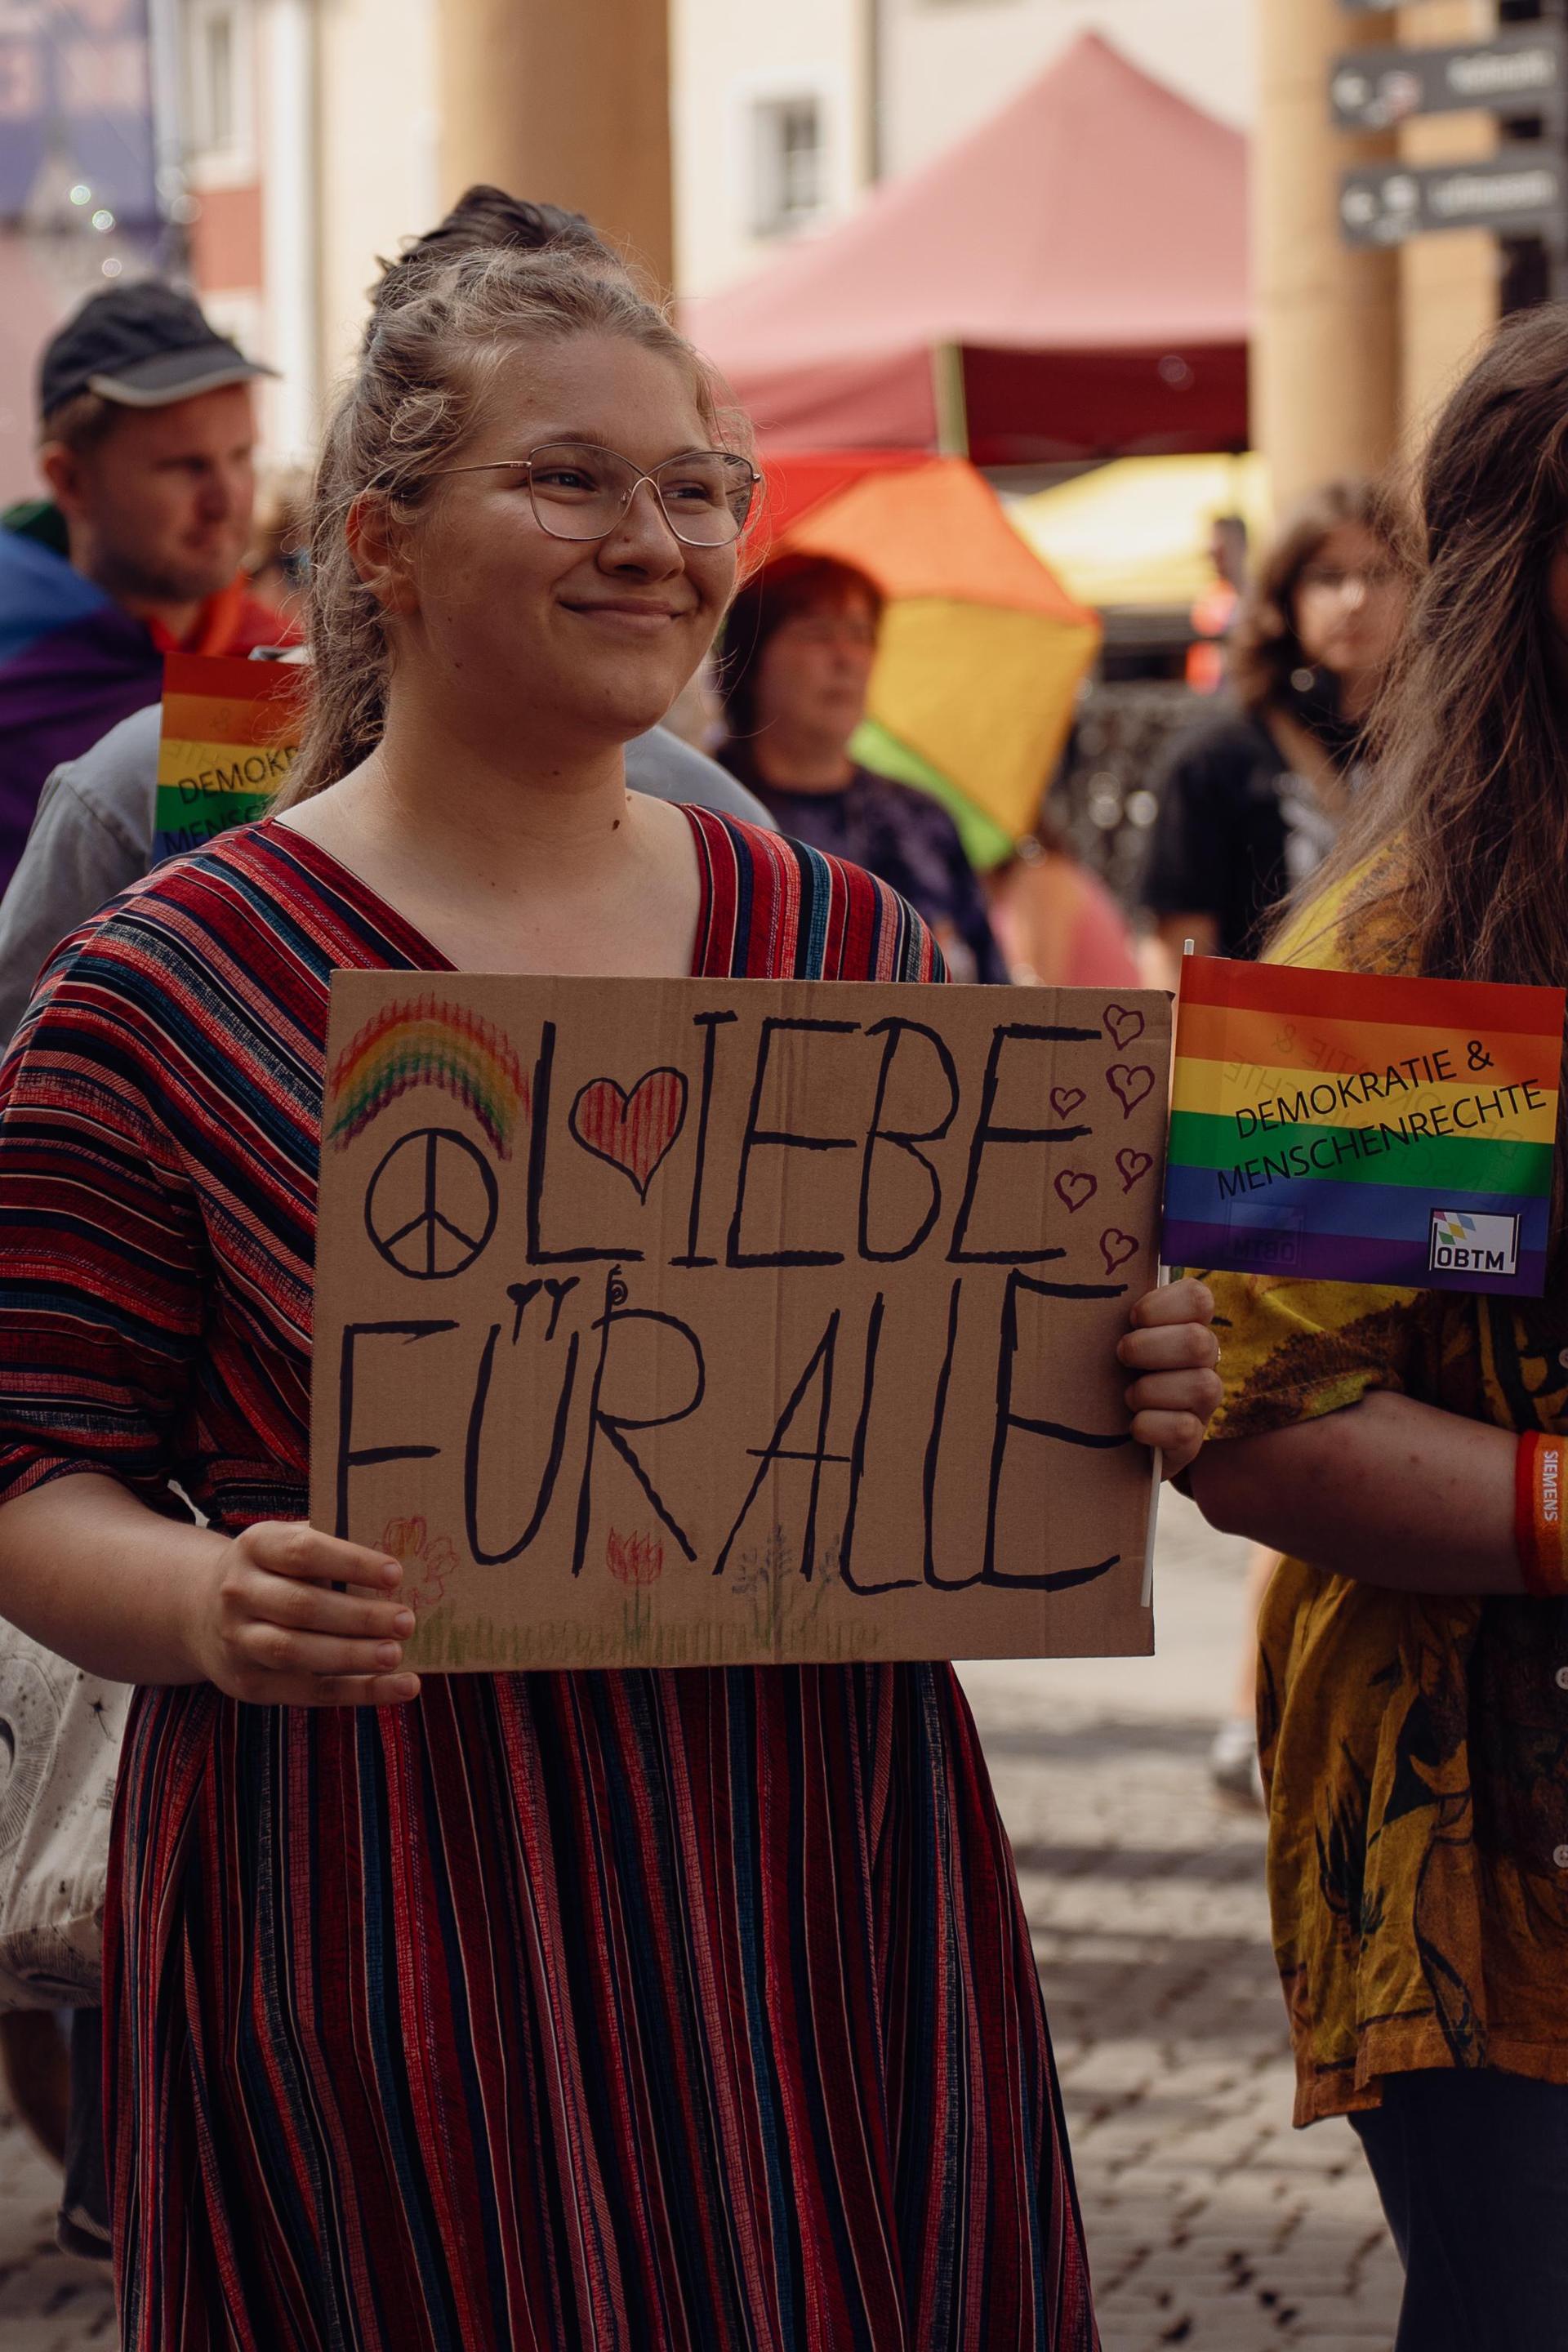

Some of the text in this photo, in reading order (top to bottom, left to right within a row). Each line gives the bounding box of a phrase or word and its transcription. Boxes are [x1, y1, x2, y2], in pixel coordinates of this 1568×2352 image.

[526, 1011, 1102, 1268] LIEBE
[1217, 1078, 1547, 1200] MENSCHENRECHTE
[1235, 1040, 1494, 1139] DEMOKRATIE &
[1437, 1245, 1505, 1272] OBTM
[331, 1265, 1133, 1595] FÜR ALLE
[1543, 1450, 1559, 1522] SIEMENS
